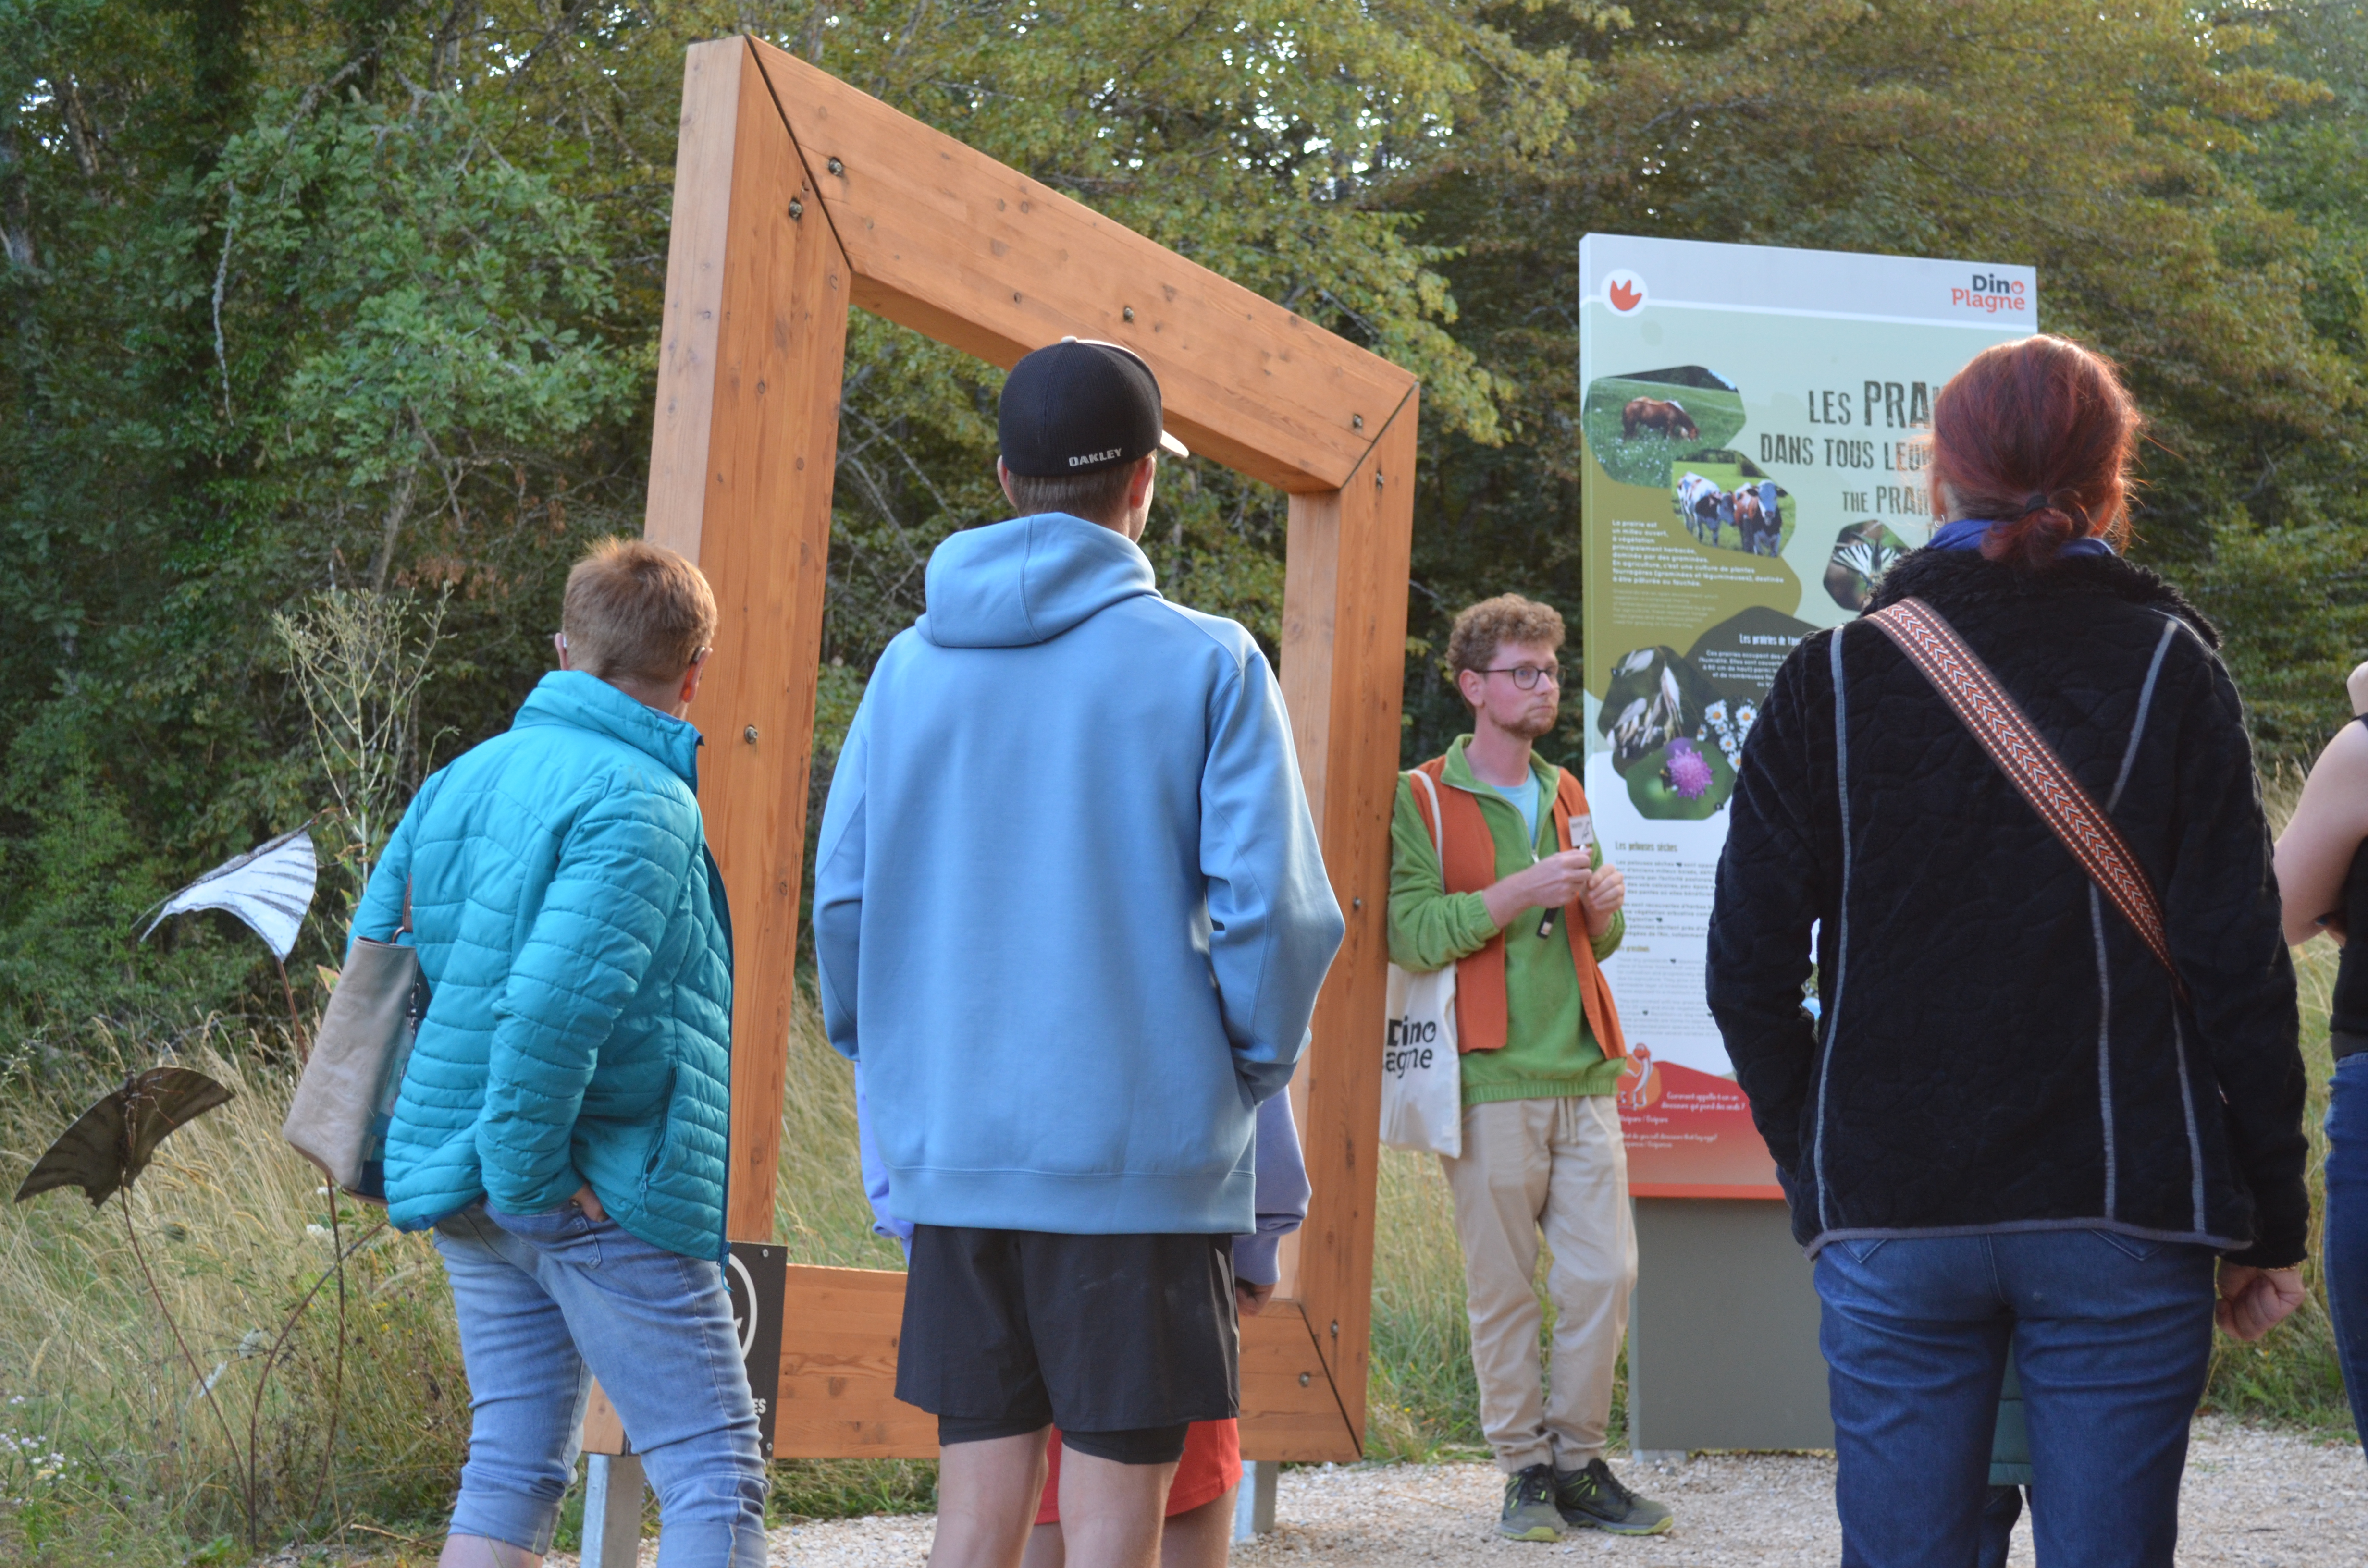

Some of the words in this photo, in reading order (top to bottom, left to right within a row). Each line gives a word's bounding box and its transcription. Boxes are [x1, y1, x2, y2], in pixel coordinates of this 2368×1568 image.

[1973, 273, 2024, 294] Dino
[1951, 287, 2025, 313] Plagne
[1809, 390, 1851, 425] LES
[1069, 447, 1122, 467] OAKLEY
[1761, 433, 1813, 466] DANS
[1825, 439, 1874, 469] TOUS
[1843, 491, 1869, 512] THE
[1616, 841, 1626, 850] Les
[1383, 1047, 1433, 1079] agne
